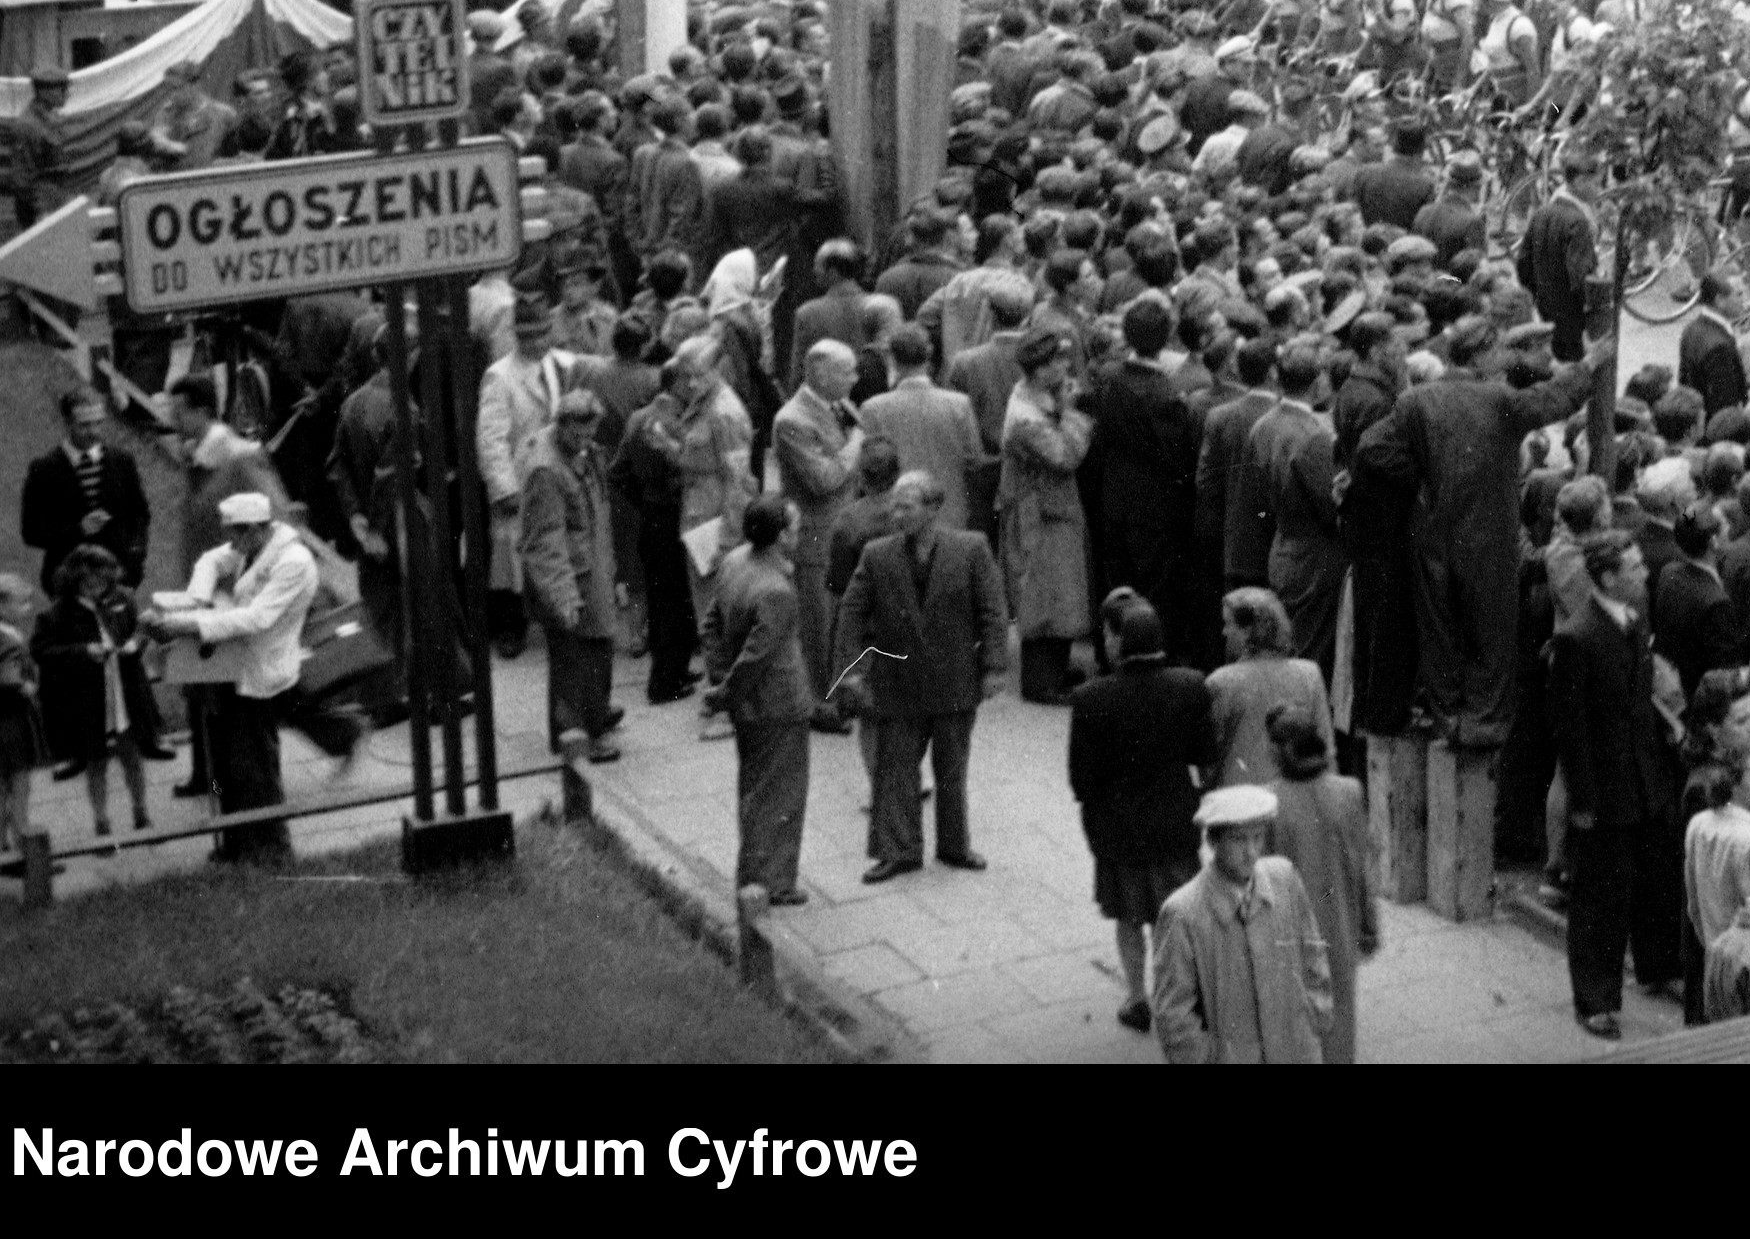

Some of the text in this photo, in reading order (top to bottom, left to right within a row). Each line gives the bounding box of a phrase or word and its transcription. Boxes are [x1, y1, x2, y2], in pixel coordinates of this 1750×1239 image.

[373, 3, 448, 41] CZY
[378, 37, 452, 74] TEL
[144, 166, 500, 251] OGŁOSZENIA
[152, 219, 499, 296] DO WSZYSTKICH PISM
